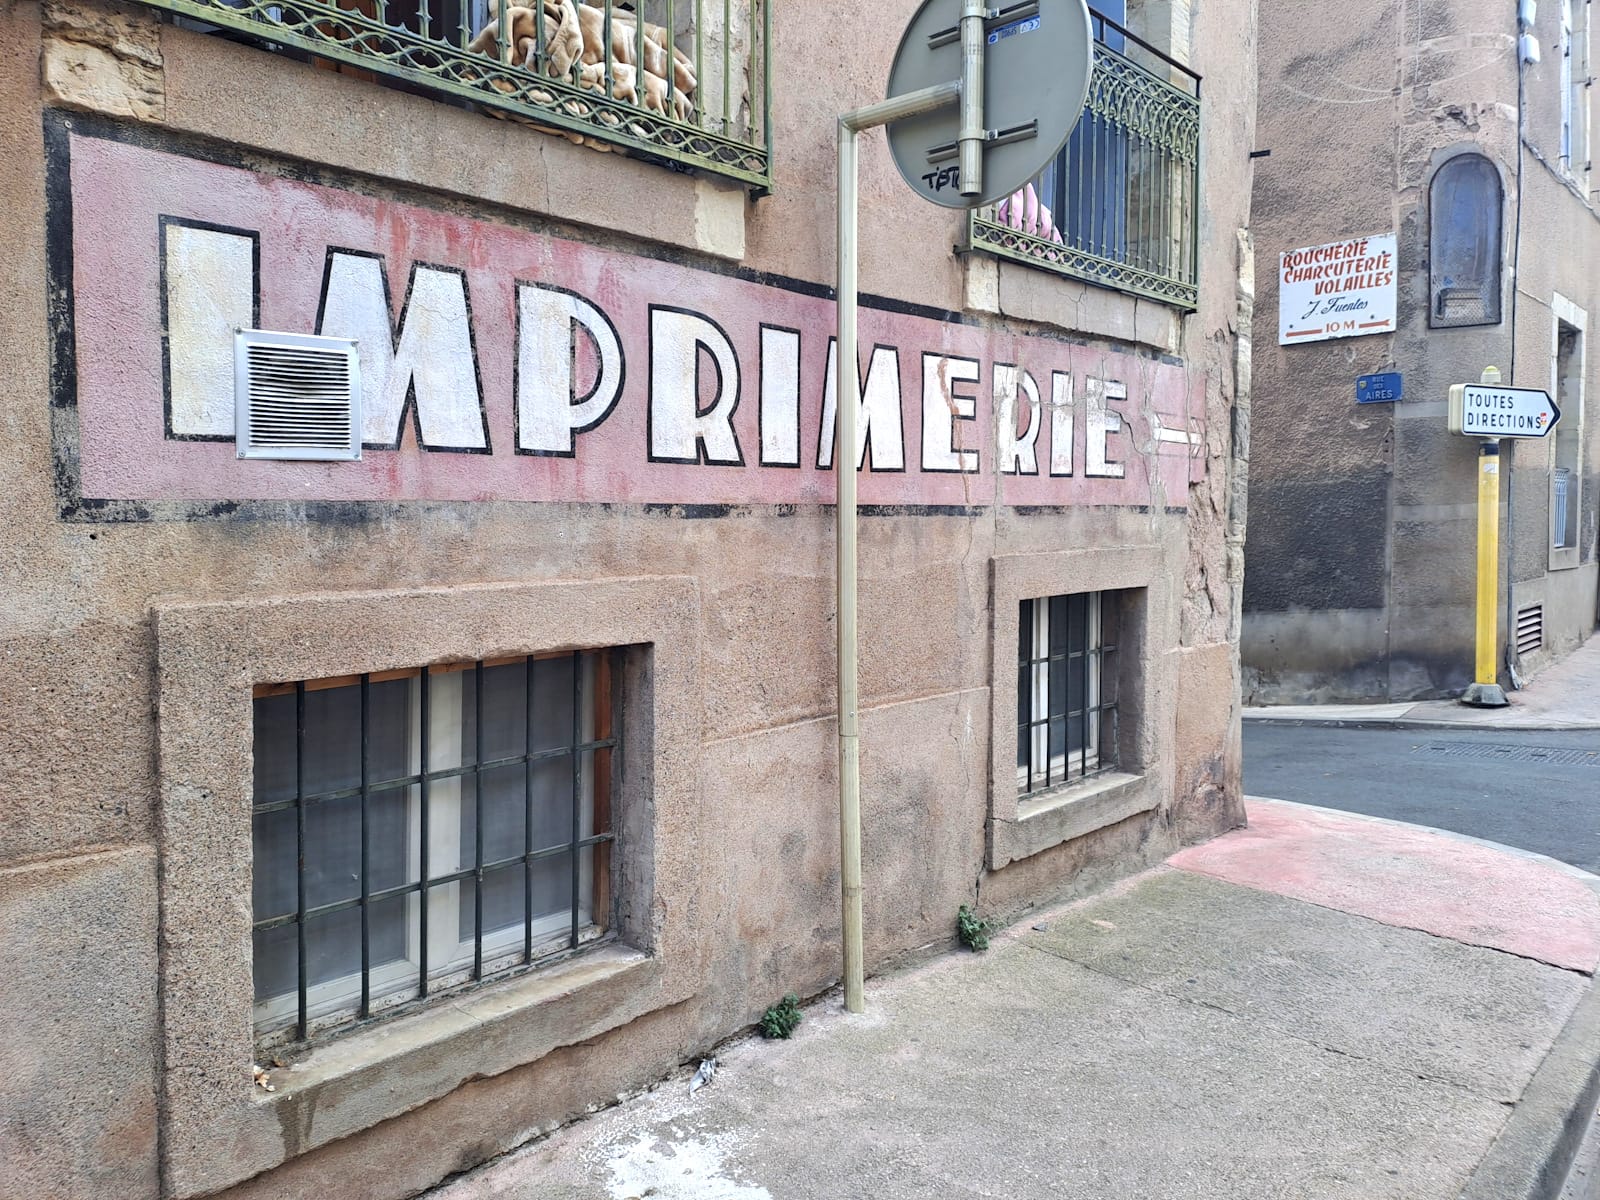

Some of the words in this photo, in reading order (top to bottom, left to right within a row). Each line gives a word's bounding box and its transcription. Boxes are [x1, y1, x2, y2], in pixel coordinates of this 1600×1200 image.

[1283, 241, 1368, 268] BOUCHERIE
[1284, 253, 1392, 284] CHARCUTERIE
[1315, 271, 1393, 295] VOLAILLES
[1321, 297, 1368, 315] Fuentes
[1343, 320, 1355, 330] M
[158, 213, 1127, 479] IMPRIMERIE
[1366, 390, 1393, 400] AIRES
[1468, 394, 1514, 409] TOUTES
[1467, 412, 1541, 429] DIRECTIONS
